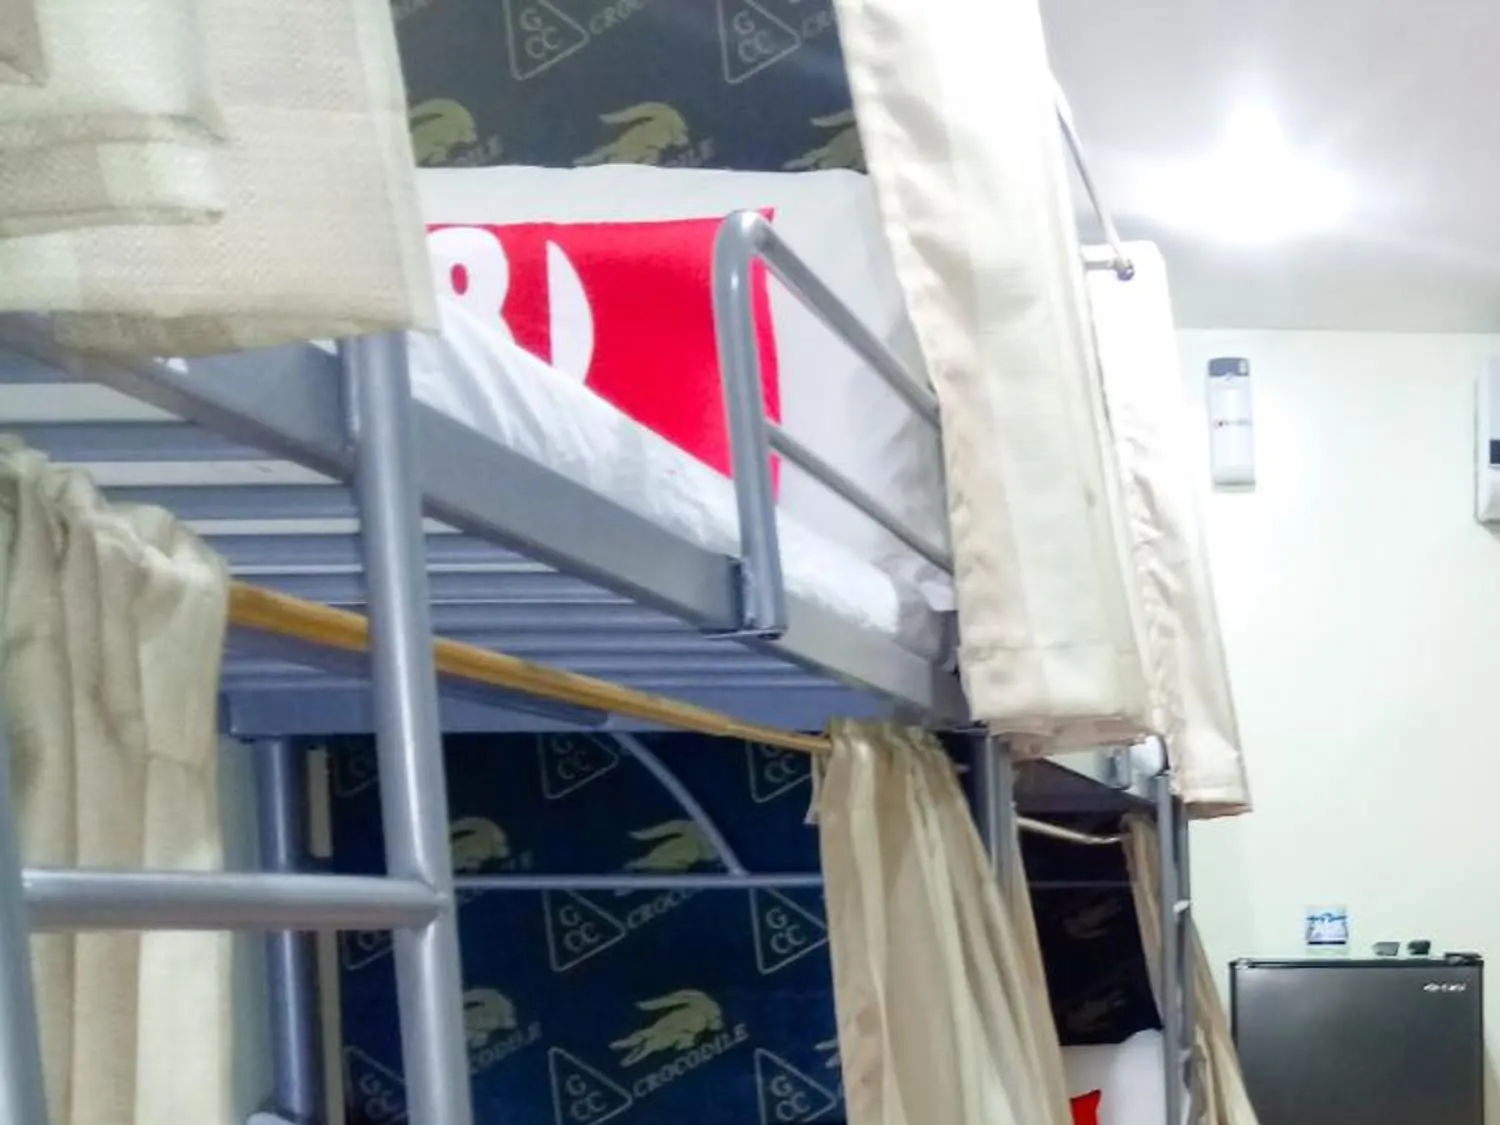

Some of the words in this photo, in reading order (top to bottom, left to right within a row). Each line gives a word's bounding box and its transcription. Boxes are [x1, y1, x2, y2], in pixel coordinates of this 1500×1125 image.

[520, 8, 542, 31] G
[733, 11, 755, 34] G
[525, 27, 560, 59] CC
[738, 30, 775, 63] CC
[766, 908, 789, 930] G
[769, 924, 808, 954] CC
[632, 1022, 749, 1099] CROCODILE
[565, 1073, 587, 1096] G
[770, 1075, 793, 1098] G
[570, 1091, 607, 1121] CC
[775, 1092, 812, 1121] CC
